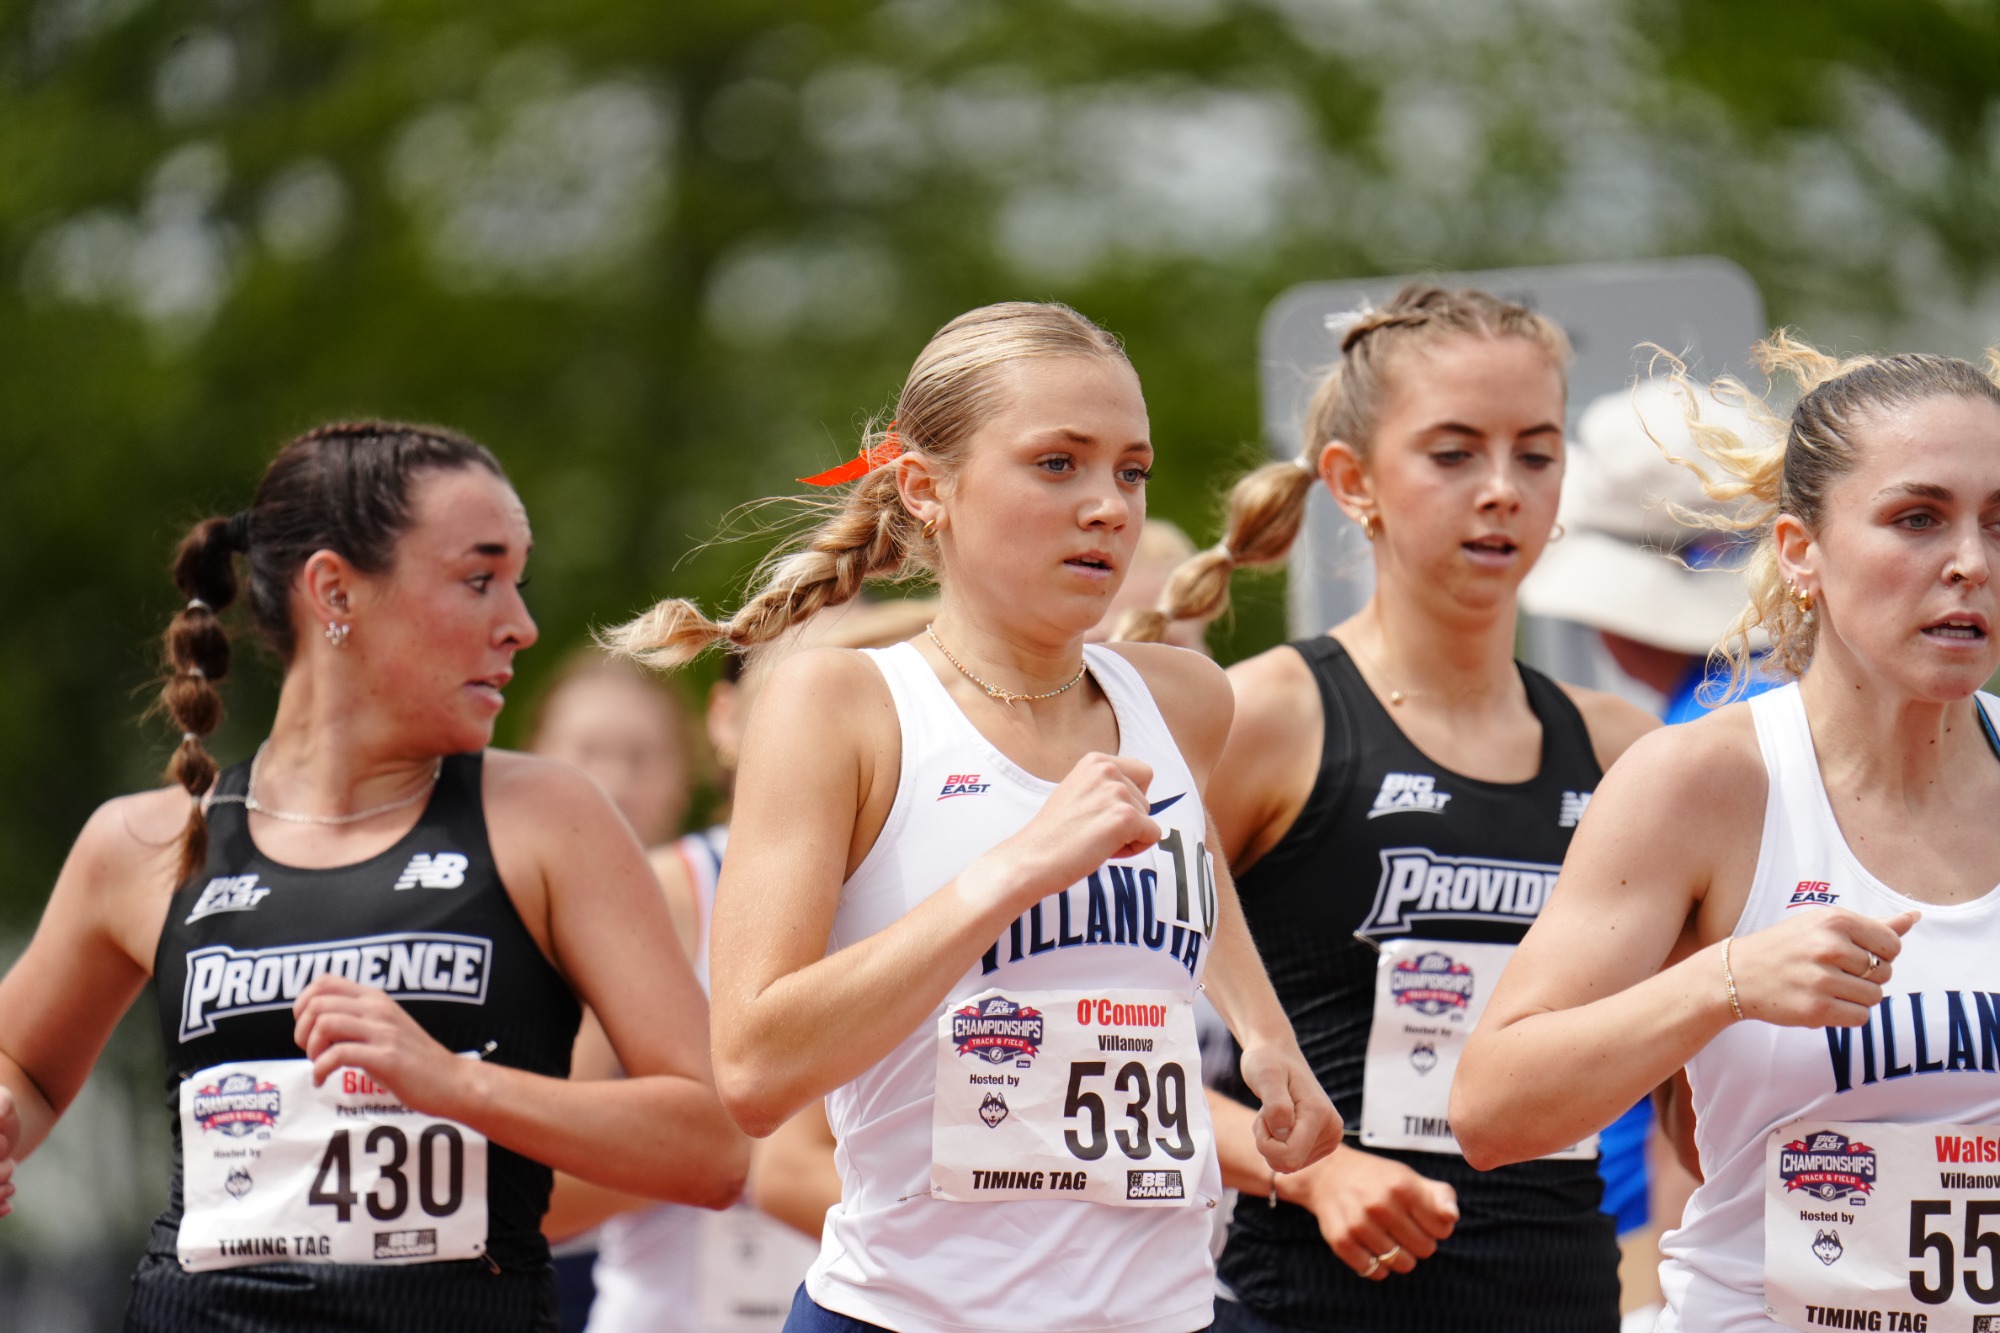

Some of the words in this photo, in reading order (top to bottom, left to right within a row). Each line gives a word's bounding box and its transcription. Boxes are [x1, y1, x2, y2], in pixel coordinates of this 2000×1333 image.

[946, 774, 981, 785] BIG
[1381, 773, 1436, 792] BIG
[940, 784, 991, 795] EAST
[1159, 828, 1216, 941] 10
[1795, 881, 1830, 892] BIG
[1790, 892, 1840, 903] EAST
[990, 1000, 1009, 1008] BIG
[1077, 999, 1167, 1028] O'Connor
[955, 1019, 1041, 1038] CHAMPIONSHIPS
[972, 1038, 993, 1046] TRACK
[1004, 1038, 1024, 1047] FIELD
[1098, 1035, 1153, 1052] Villanova
[970, 1074, 1004, 1085] Hosted
[1008, 1074, 1019, 1087] by
[1064, 1061, 1195, 1161] 539
[308, 1123, 464, 1223] 430
[1782, 1154, 1874, 1176] CHAMPIONSHIPS
[972, 1170, 1044, 1190] TIMING
[1049, 1171, 1087, 1190] TAG
[1800, 1174, 1824, 1182] TRACK
[1834, 1175, 1856, 1183] FIELD
[1129, 1187, 1182, 1197] CHANGE
[1800, 1210, 1837, 1222] Hosted
[1841, 1212, 1854, 1224] by
[219, 1237, 288, 1257] TIMING
[293, 1235, 330, 1256] TAG
[1805, 1305, 1882, 1332] TIMING
[1887, 1311, 1928, 1333] TAG
